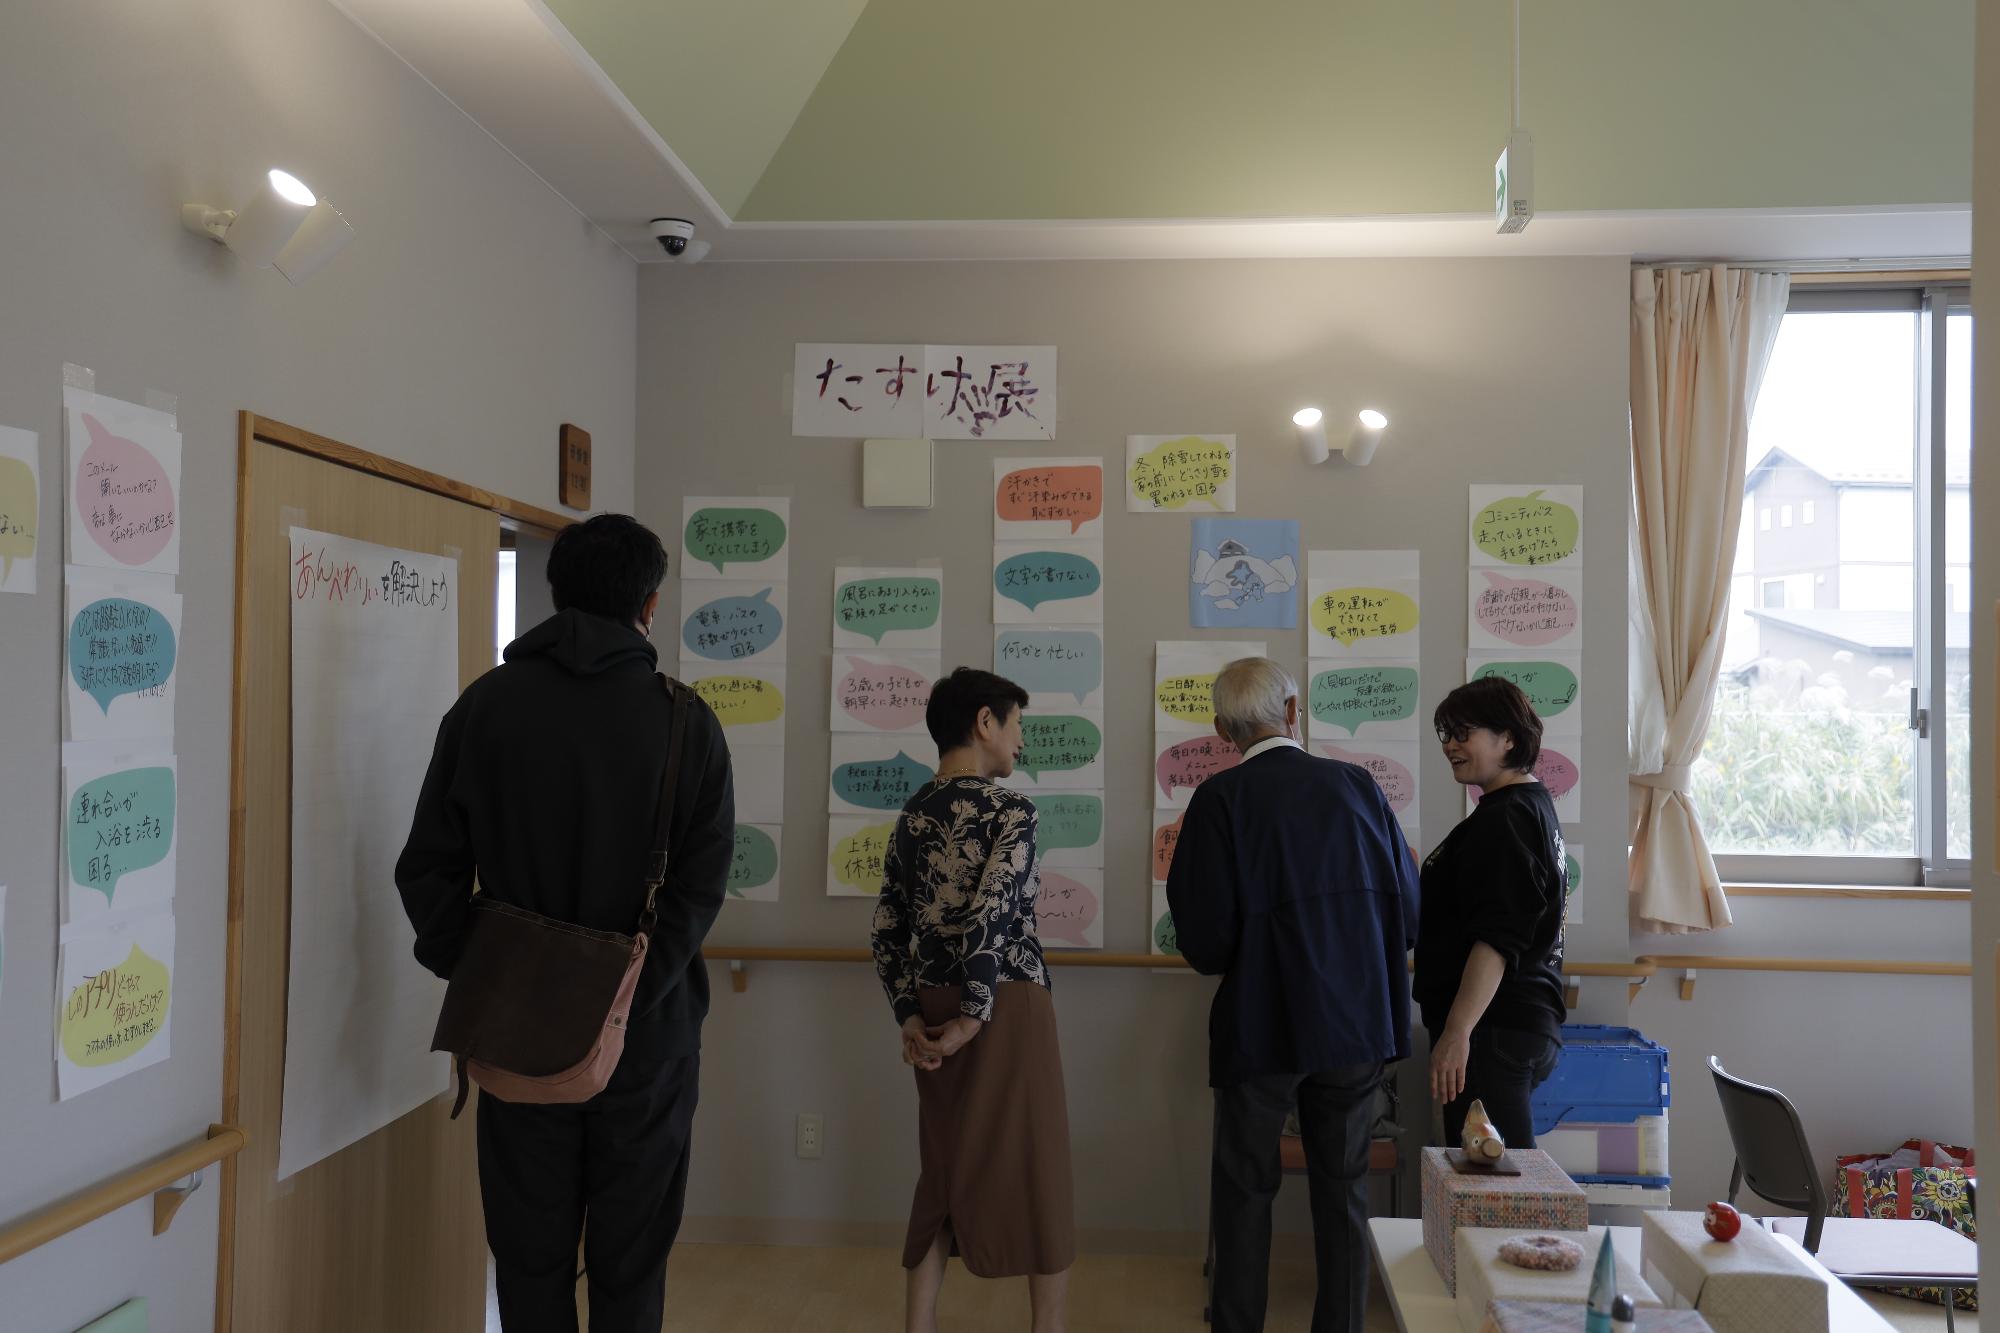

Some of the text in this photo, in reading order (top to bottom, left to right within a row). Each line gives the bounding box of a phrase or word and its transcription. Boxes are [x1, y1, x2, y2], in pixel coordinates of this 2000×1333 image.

[1007, 473, 1054, 491] 汗かきで
[1134, 464, 1229, 493] 家の前にどっさり雪を
[1150, 483, 1217, 508] 置かれると困る
[1484, 506, 1553, 524] コミュニティバス
[693, 515, 758, 542] 家で携帯を
[1479, 525, 1553, 544] 走っているときに
[705, 539, 770, 556] なくしてしまう
[1500, 538, 1558, 561] 手をあげたら
[1528, 548, 1578, 565] 乗せてほしい
[1004, 565, 1090, 587] 文字が書けない
[842, 585, 935, 605] 風呂にあまり入らない
[1323, 594, 1389, 615] 車の運転が
[841, 603, 928, 622] 家族の足がくさい
[1338, 611, 1379, 625] できなくて
[697, 624, 763, 650] 本数が少なくて
[1327, 624, 1398, 640] 買い物も一苦労
[730, 641, 755, 658] 困る
[1002, 641, 1084, 661] 何かと忙しい
[847, 677, 924, 692] 3歳の子どもが
[1318, 671, 1382, 691] 人見知りだけど
[1185, 761, 1218, 771] メニュー
[77, 790, 139, 824] 連れ合いが
[96, 815, 161, 850] 入浴を渋る
[848, 837, 882, 854] 上手に
[844, 855, 882, 879] 休憩
